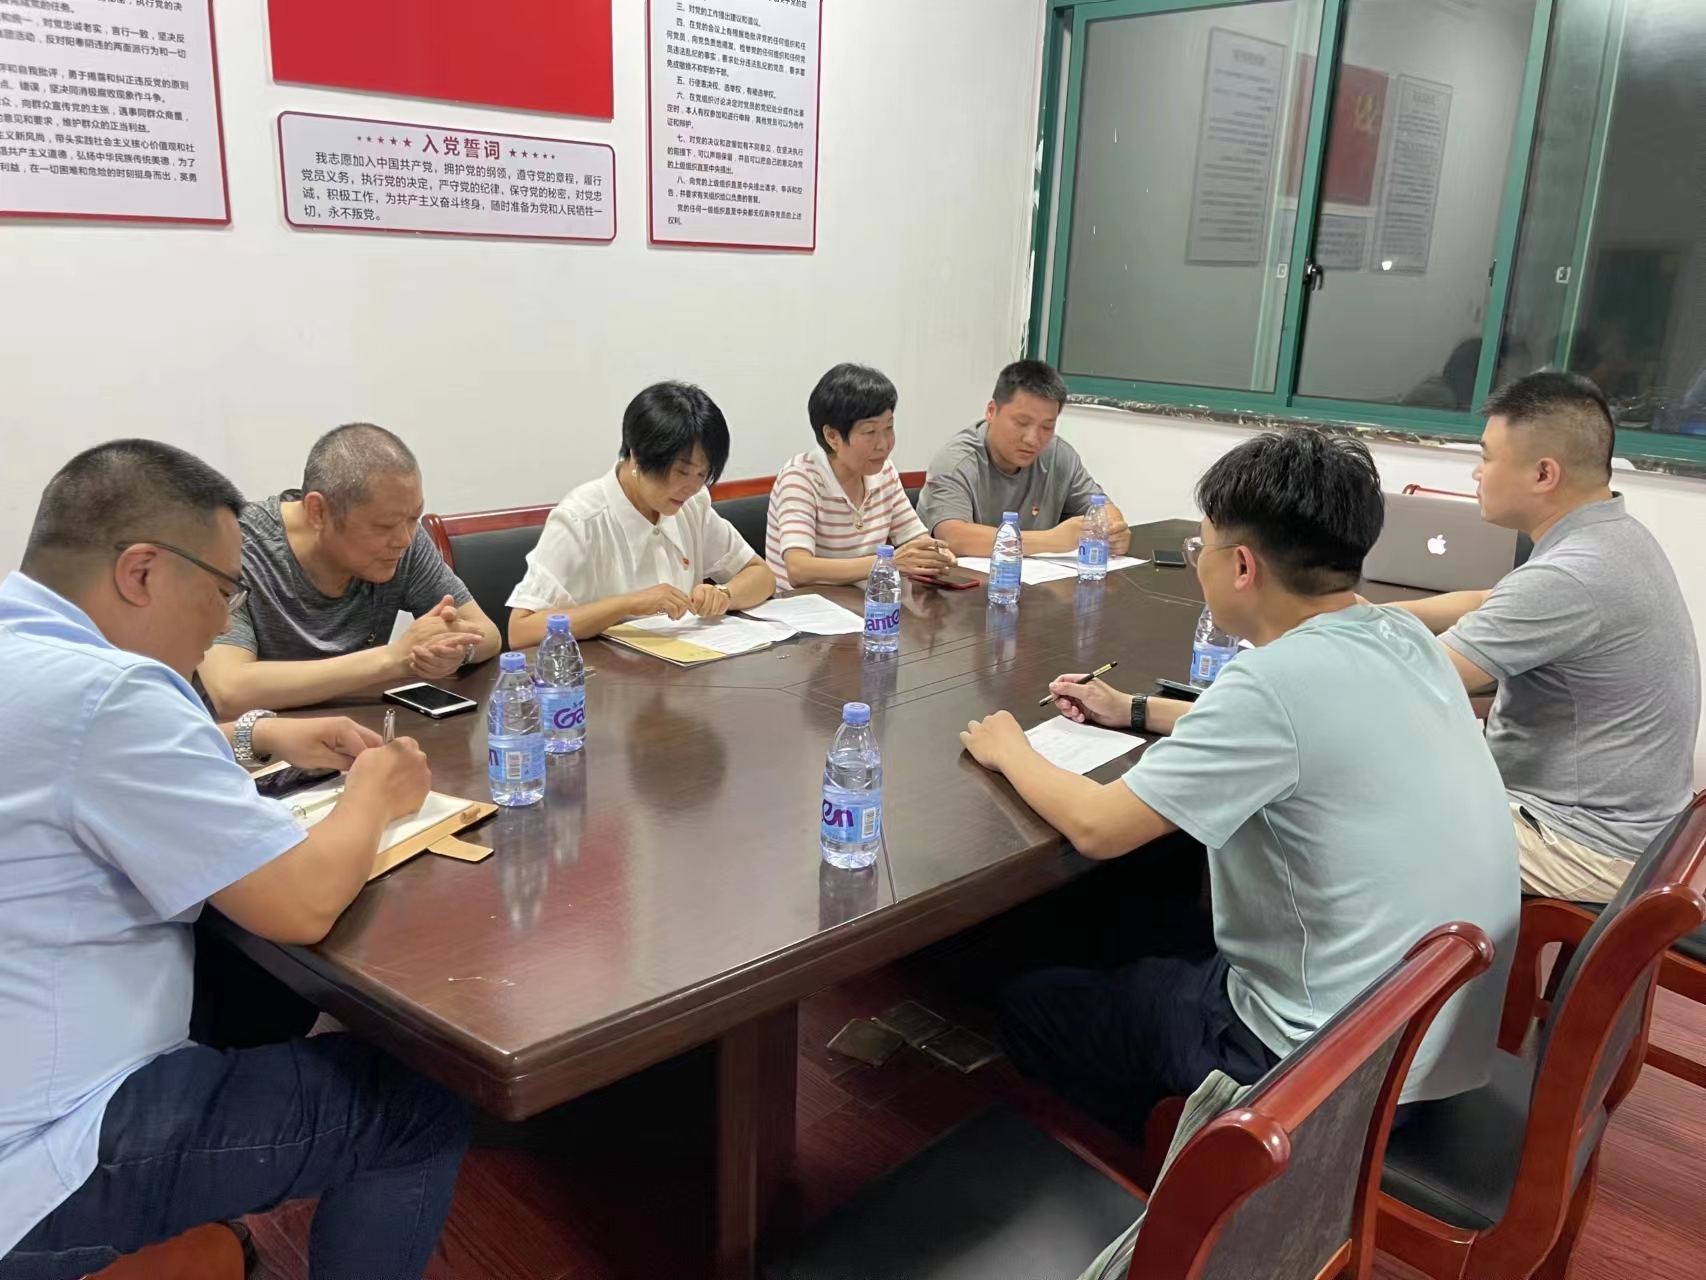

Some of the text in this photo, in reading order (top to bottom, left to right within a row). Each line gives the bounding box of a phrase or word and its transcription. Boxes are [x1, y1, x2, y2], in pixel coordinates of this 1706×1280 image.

[0, 29, 186, 59] 团活动，反对阳奉阴违的两面派行为和一切
[421, 134, 501, 161] 入党誓词
